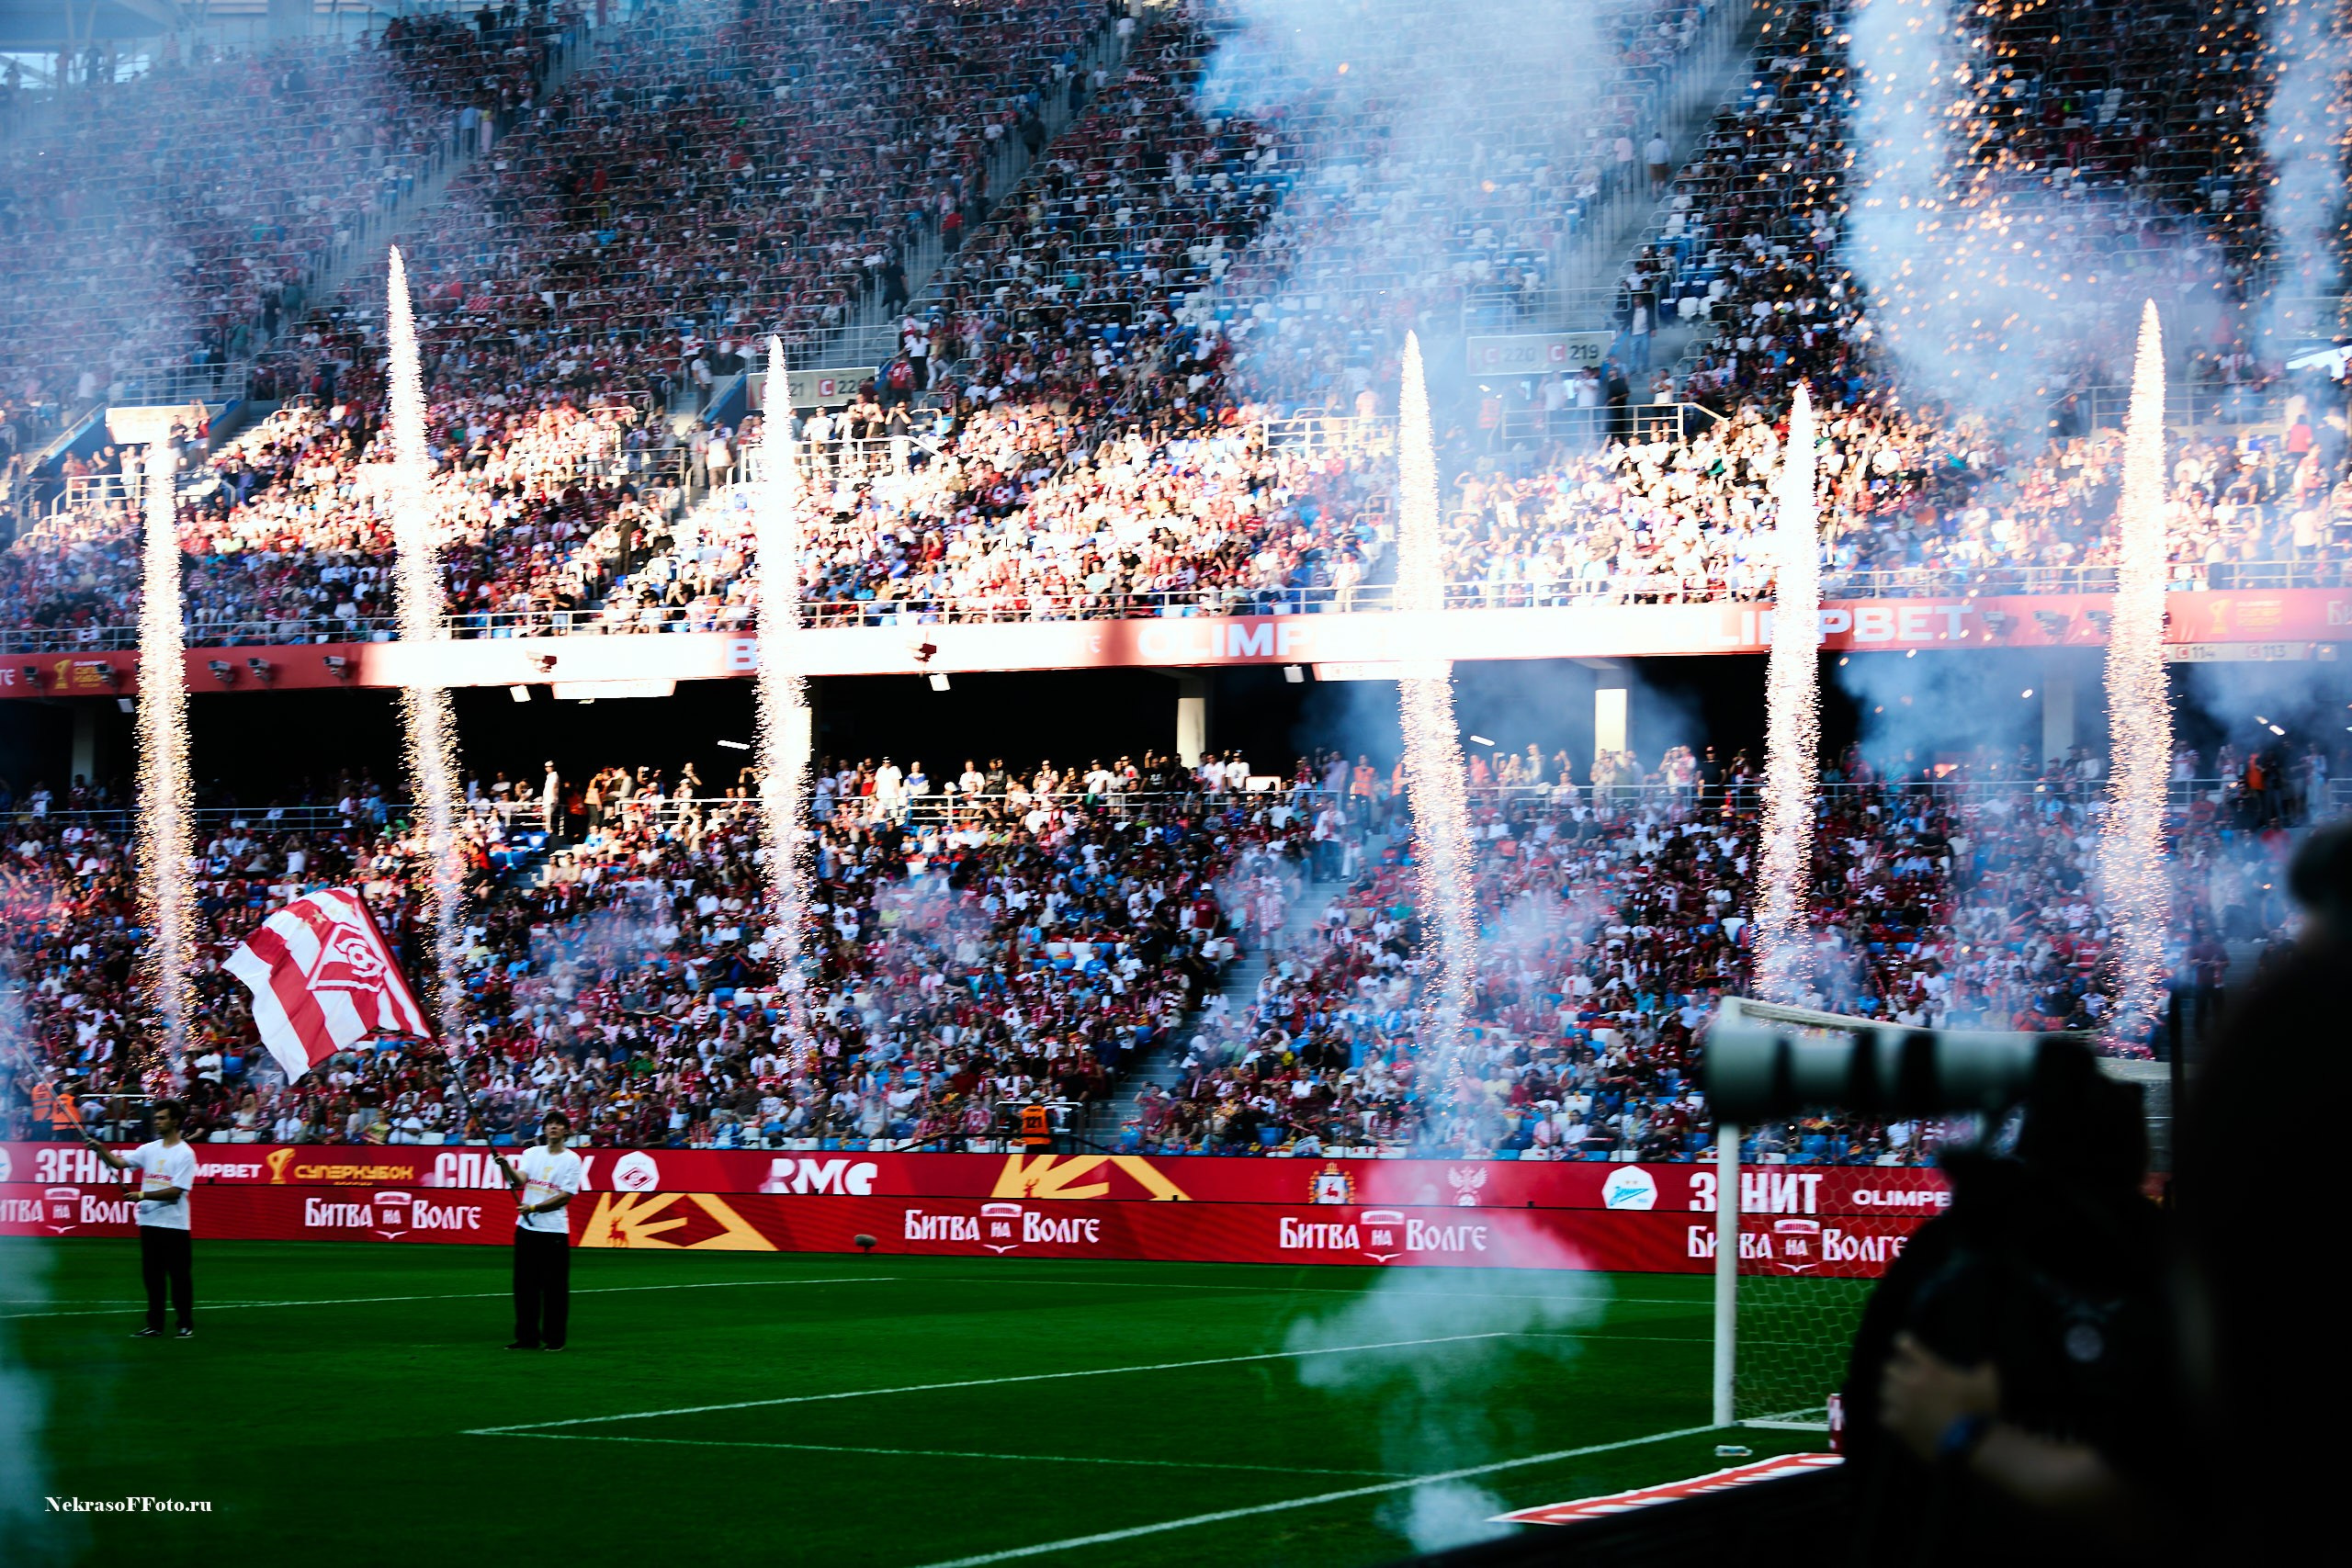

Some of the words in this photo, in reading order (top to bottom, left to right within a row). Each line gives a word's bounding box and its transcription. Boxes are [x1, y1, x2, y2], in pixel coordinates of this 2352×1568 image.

[1570, 344, 1600, 359] 219
[787, 382, 805, 396] 21
[195, 1163, 262, 1179] MPBET
[294, 1165, 413, 1180] СУПЕРКУБОК
[1689, 1171, 1823, 1214] ЗНИТ
[1852, 1190, 1951, 1207] OLIMPB
